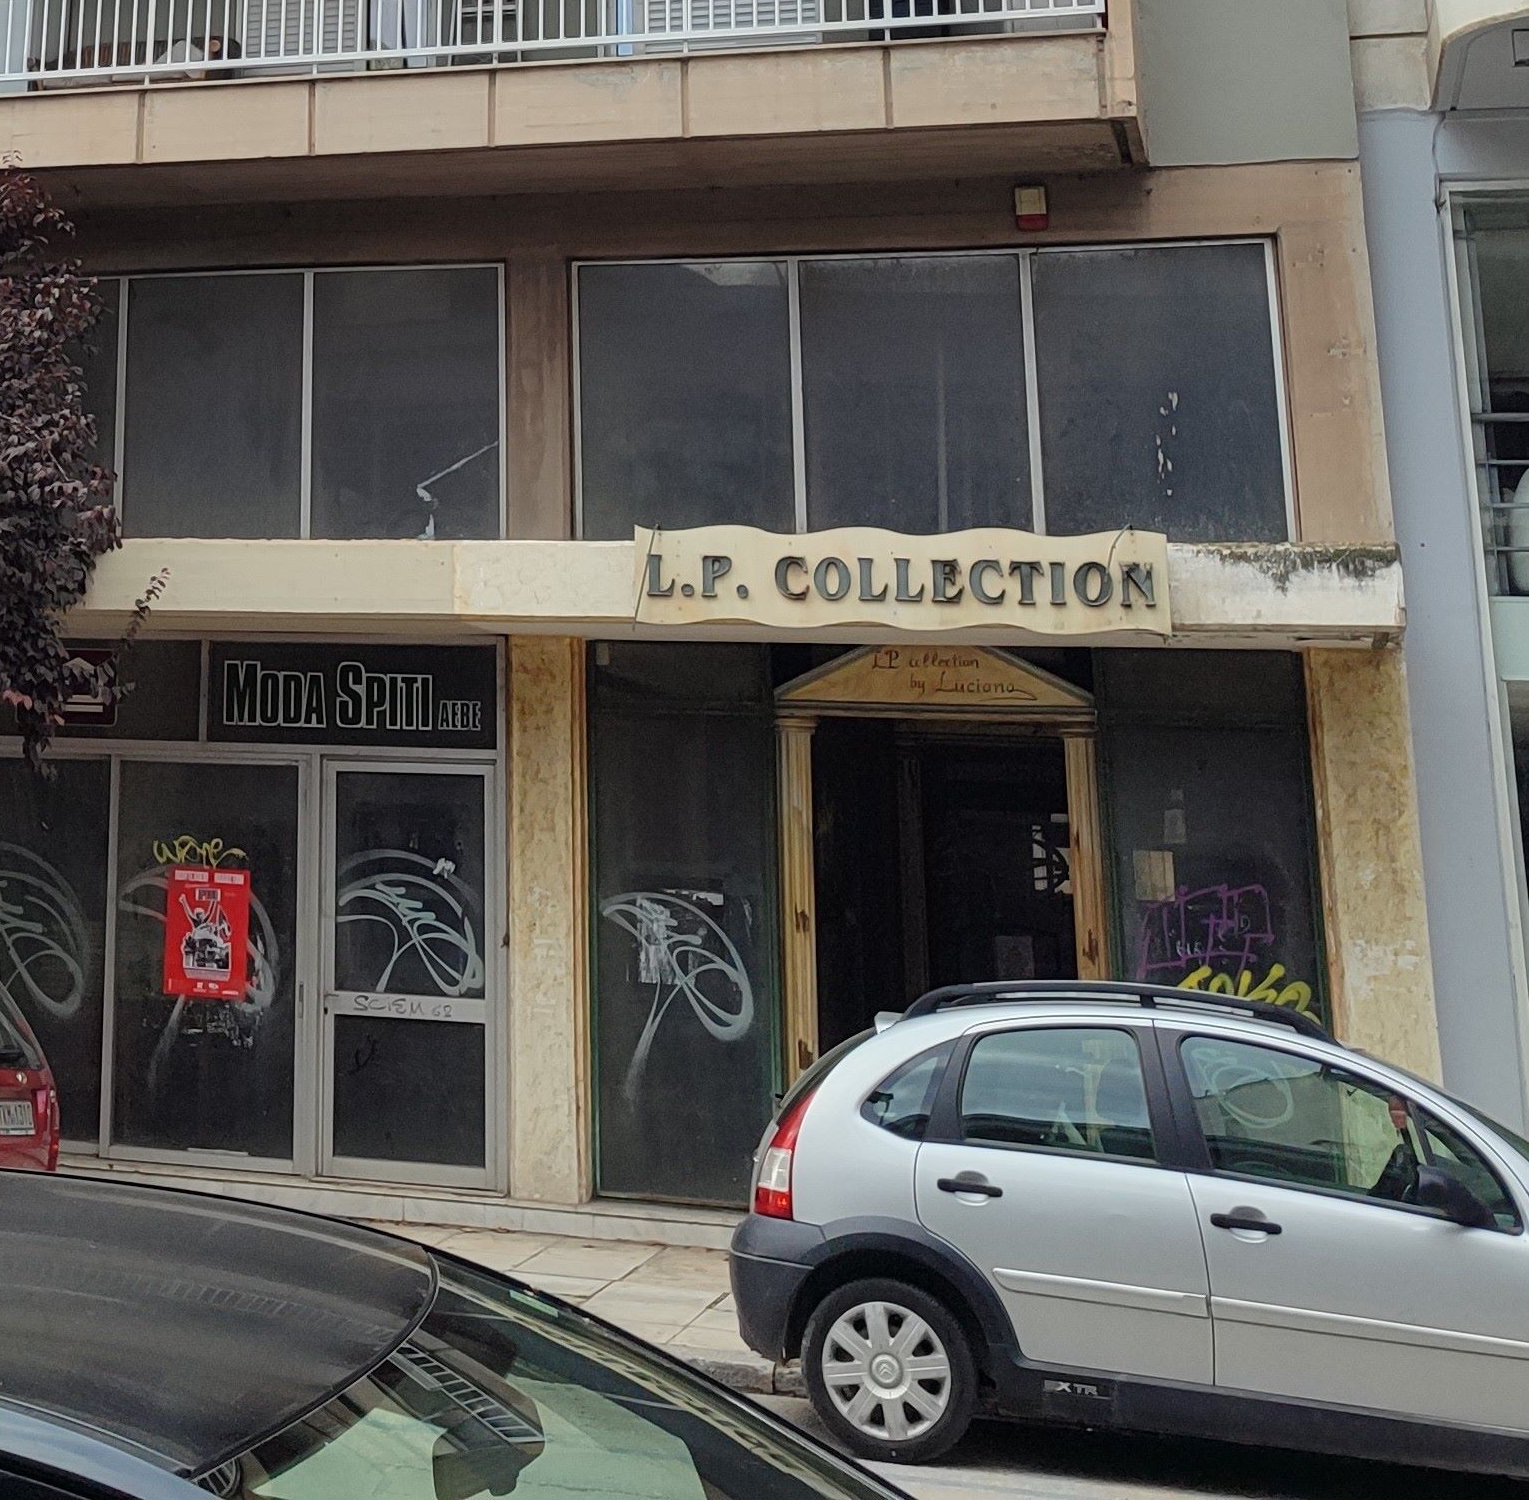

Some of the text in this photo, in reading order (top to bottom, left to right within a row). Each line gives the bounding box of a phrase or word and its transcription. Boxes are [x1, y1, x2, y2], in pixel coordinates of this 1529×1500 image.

[647, 554, 1156, 608] L.P. COLLECTION
[223, 660, 326, 728] MODA
[336, 661, 433, 731] SPITI
[910, 674, 925, 694] by
